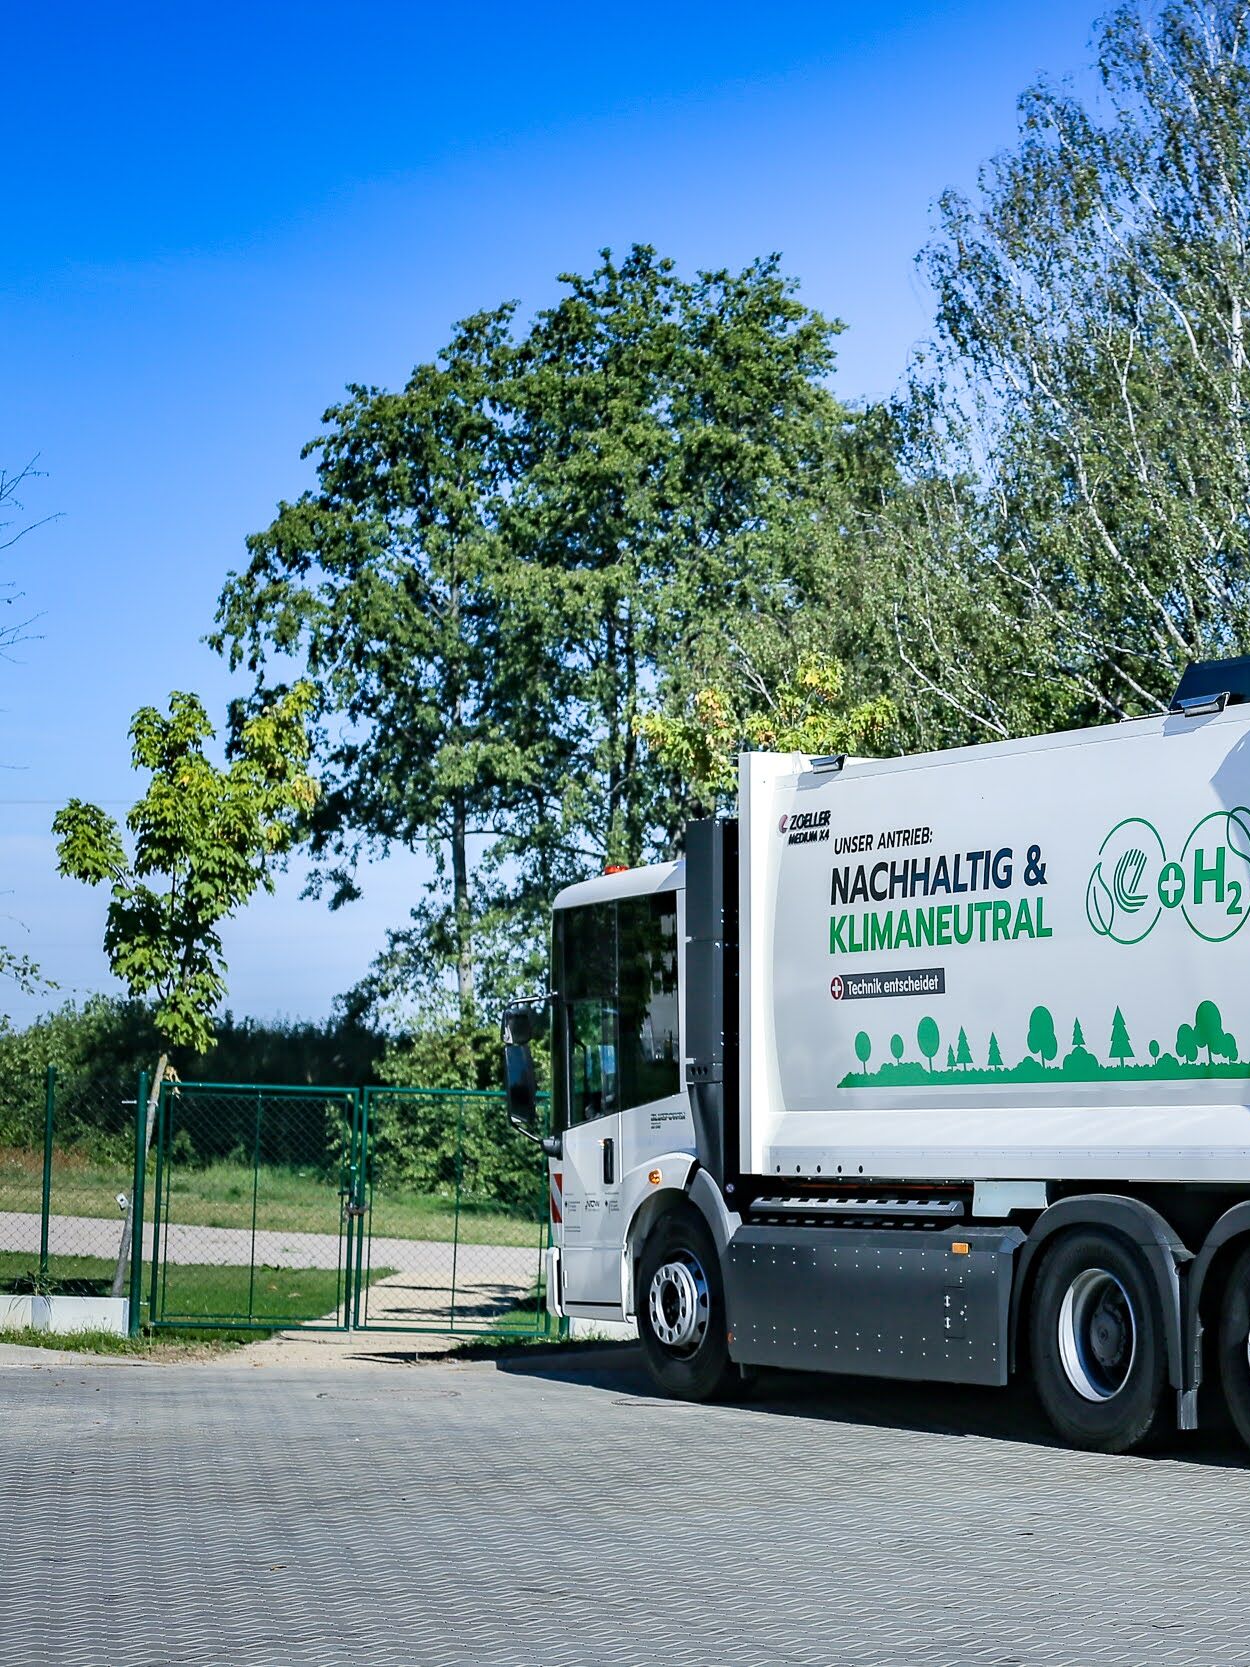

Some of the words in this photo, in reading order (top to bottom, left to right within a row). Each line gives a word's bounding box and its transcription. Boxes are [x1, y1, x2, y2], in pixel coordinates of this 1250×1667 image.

[790, 810, 831, 830] ZOELLER
[788, 830, 818, 845] MEDIUM
[819, 829, 830, 841] X4
[834, 834, 873, 855] UNSER
[877, 826, 933, 850] ANTRIEB:
[831, 847, 1013, 906] NACHHALTIG
[1023, 844, 1048, 887] &
[829, 896, 1053, 955] KLIMANEUTRAL
[847, 977, 882, 996] Technik
[883, 974, 939, 994] entscheidet
